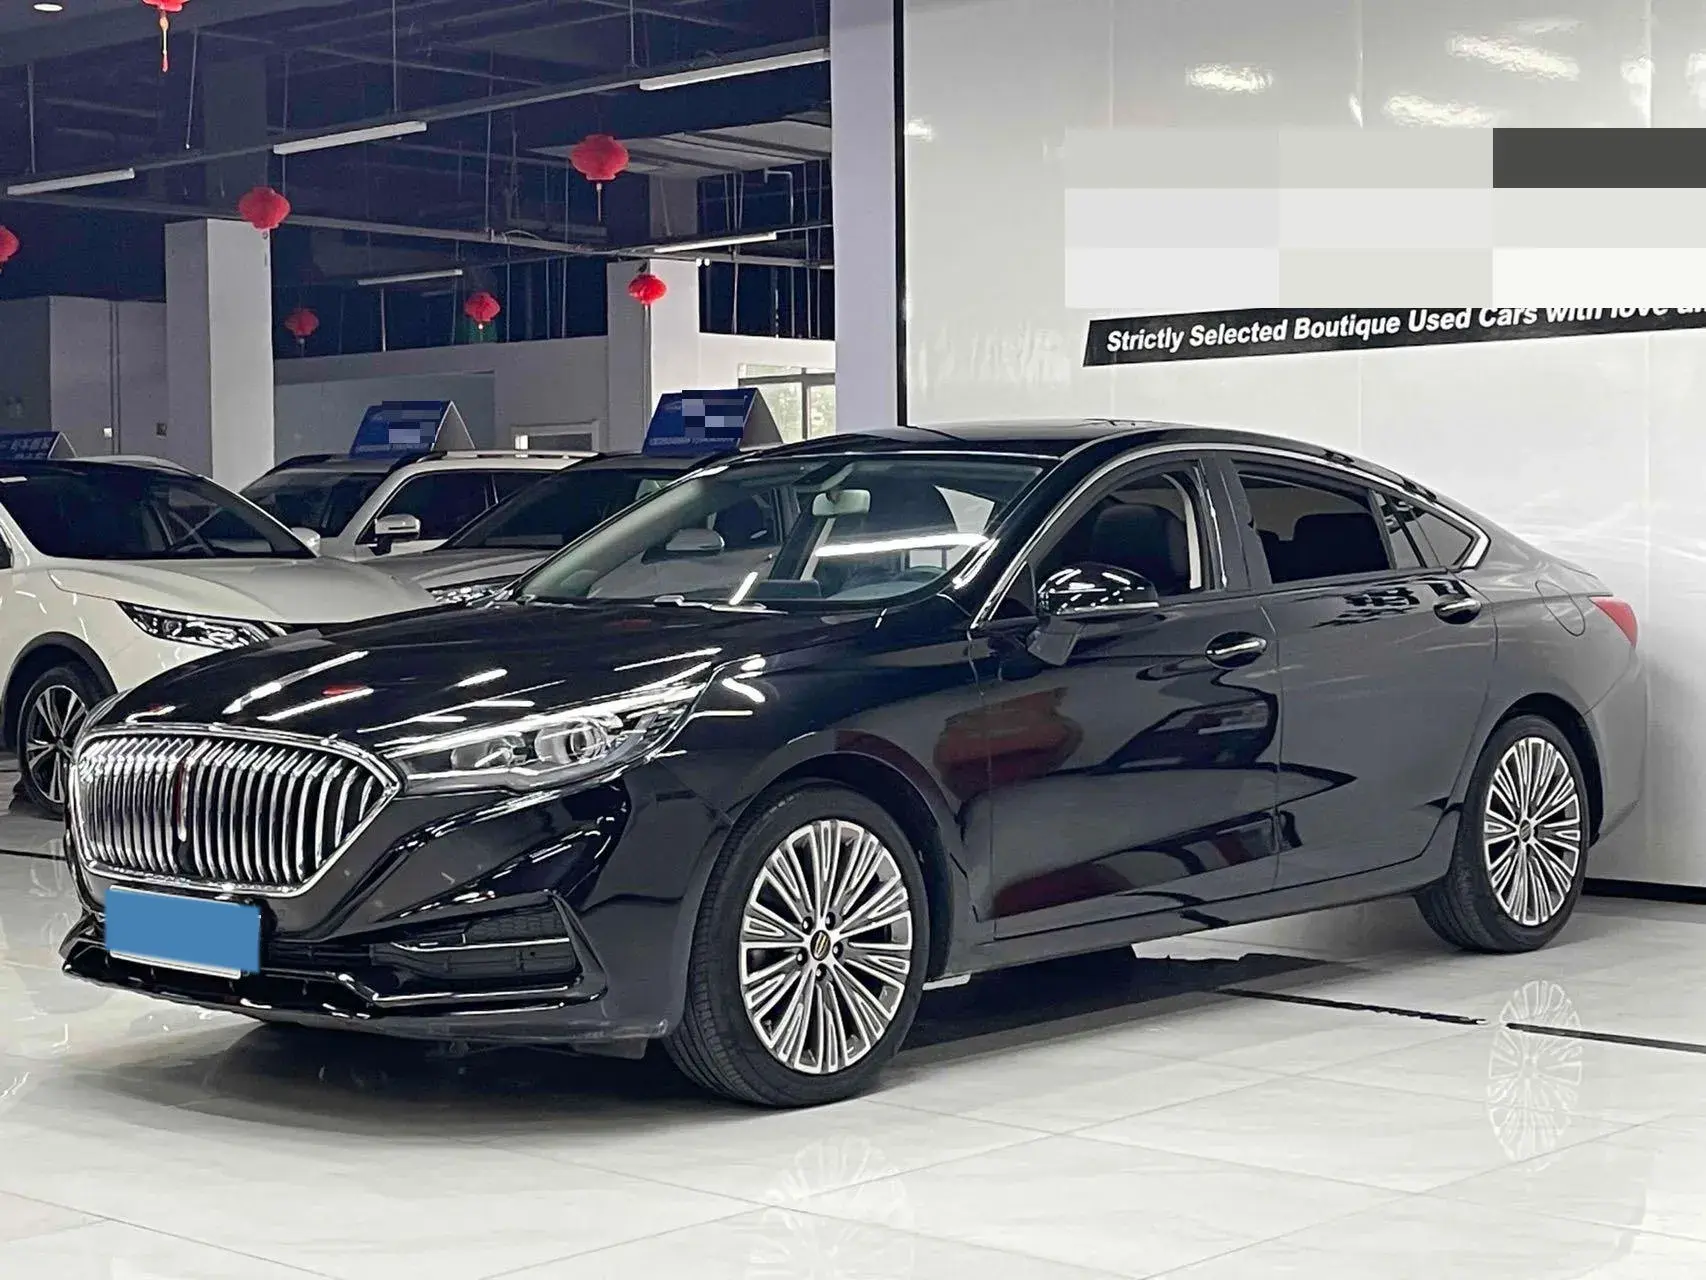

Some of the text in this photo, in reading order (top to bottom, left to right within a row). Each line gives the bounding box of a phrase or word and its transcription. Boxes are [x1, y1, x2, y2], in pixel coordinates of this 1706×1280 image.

[1107, 326, 1185, 353] Strictly
[1189, 318, 1288, 347] Selected
[1293, 313, 1400, 341] Boutique
[1408, 308, 1472, 332] Used
[1478, 308, 1538, 327] Cars
